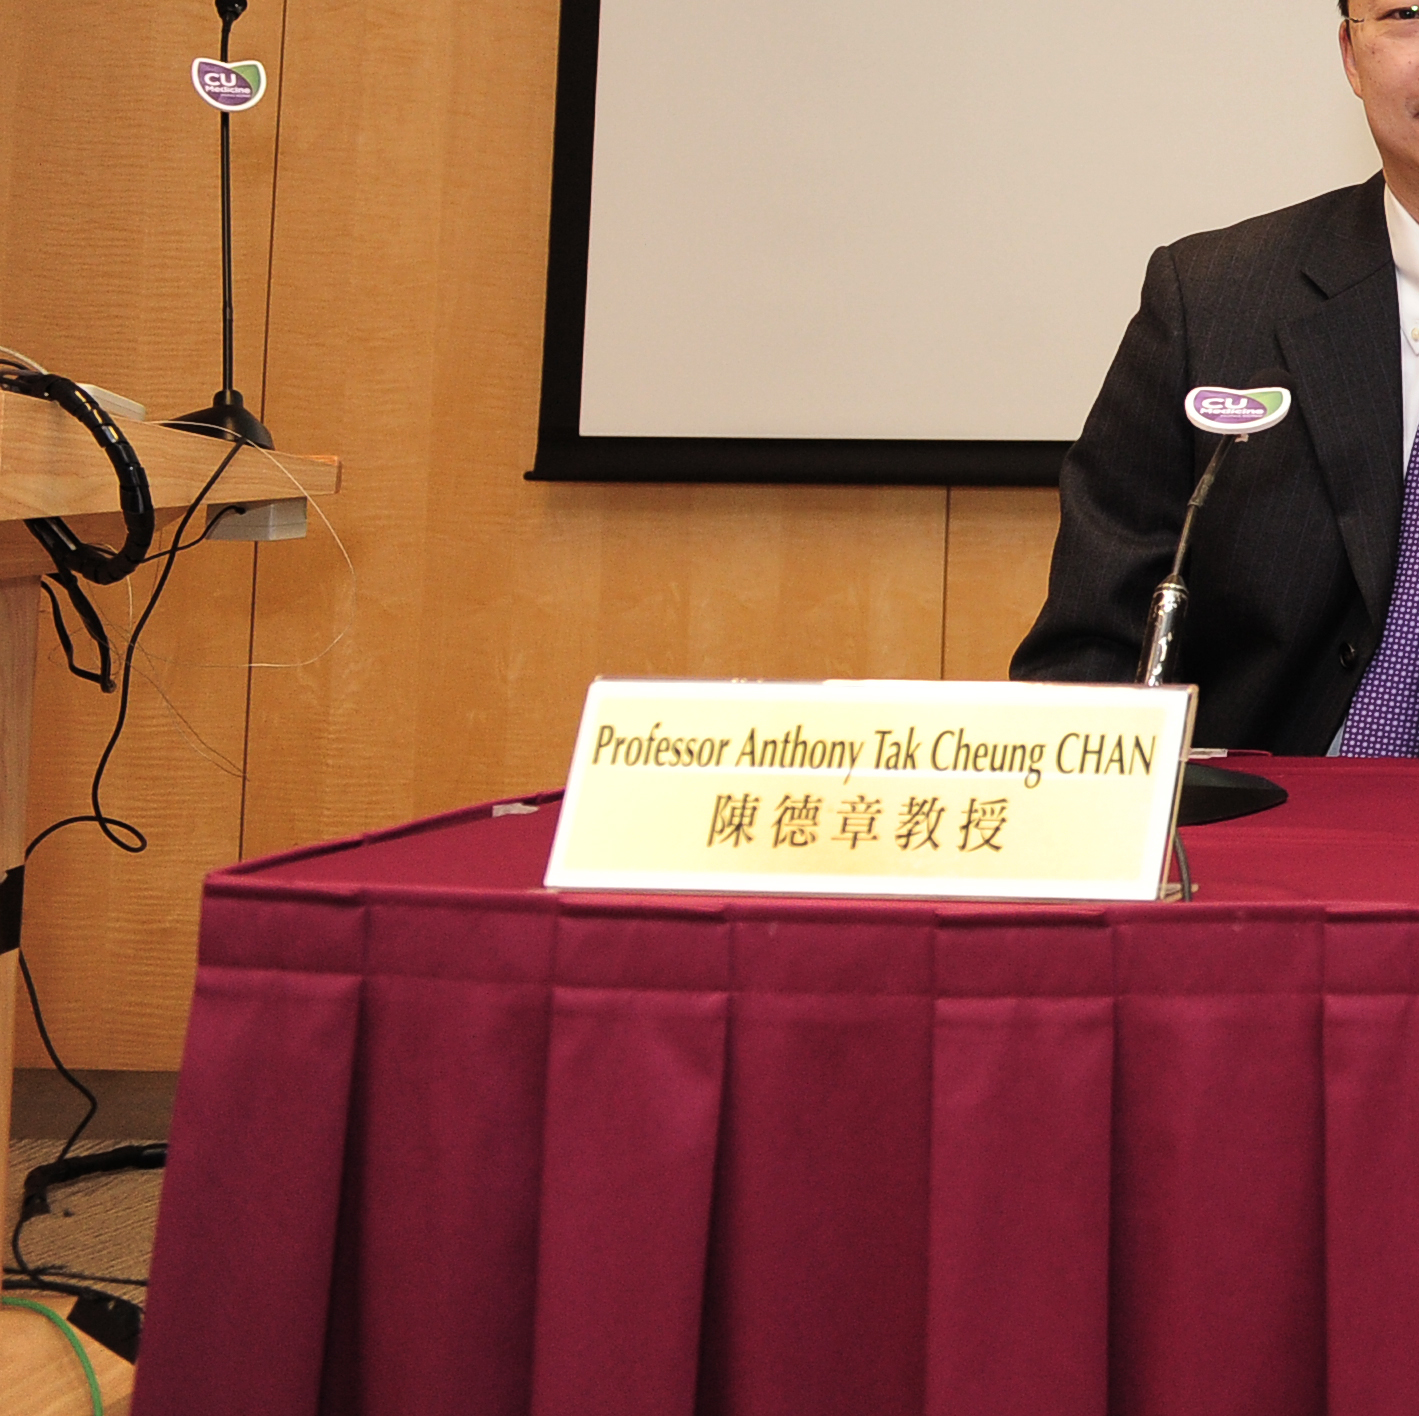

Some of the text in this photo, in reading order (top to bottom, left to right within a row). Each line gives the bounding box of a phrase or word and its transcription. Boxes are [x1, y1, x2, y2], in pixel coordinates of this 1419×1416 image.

[204, 73, 236, 87] CU
[205, 86, 251, 94] Medicine
[1202, 397, 1248, 409] CU
[1200, 407, 1264, 415] Medicine
[591, 721, 1156, 789] Professor Anthony Tak Cheung CHAN
[706, 793, 1010, 853] 陳德章教授
